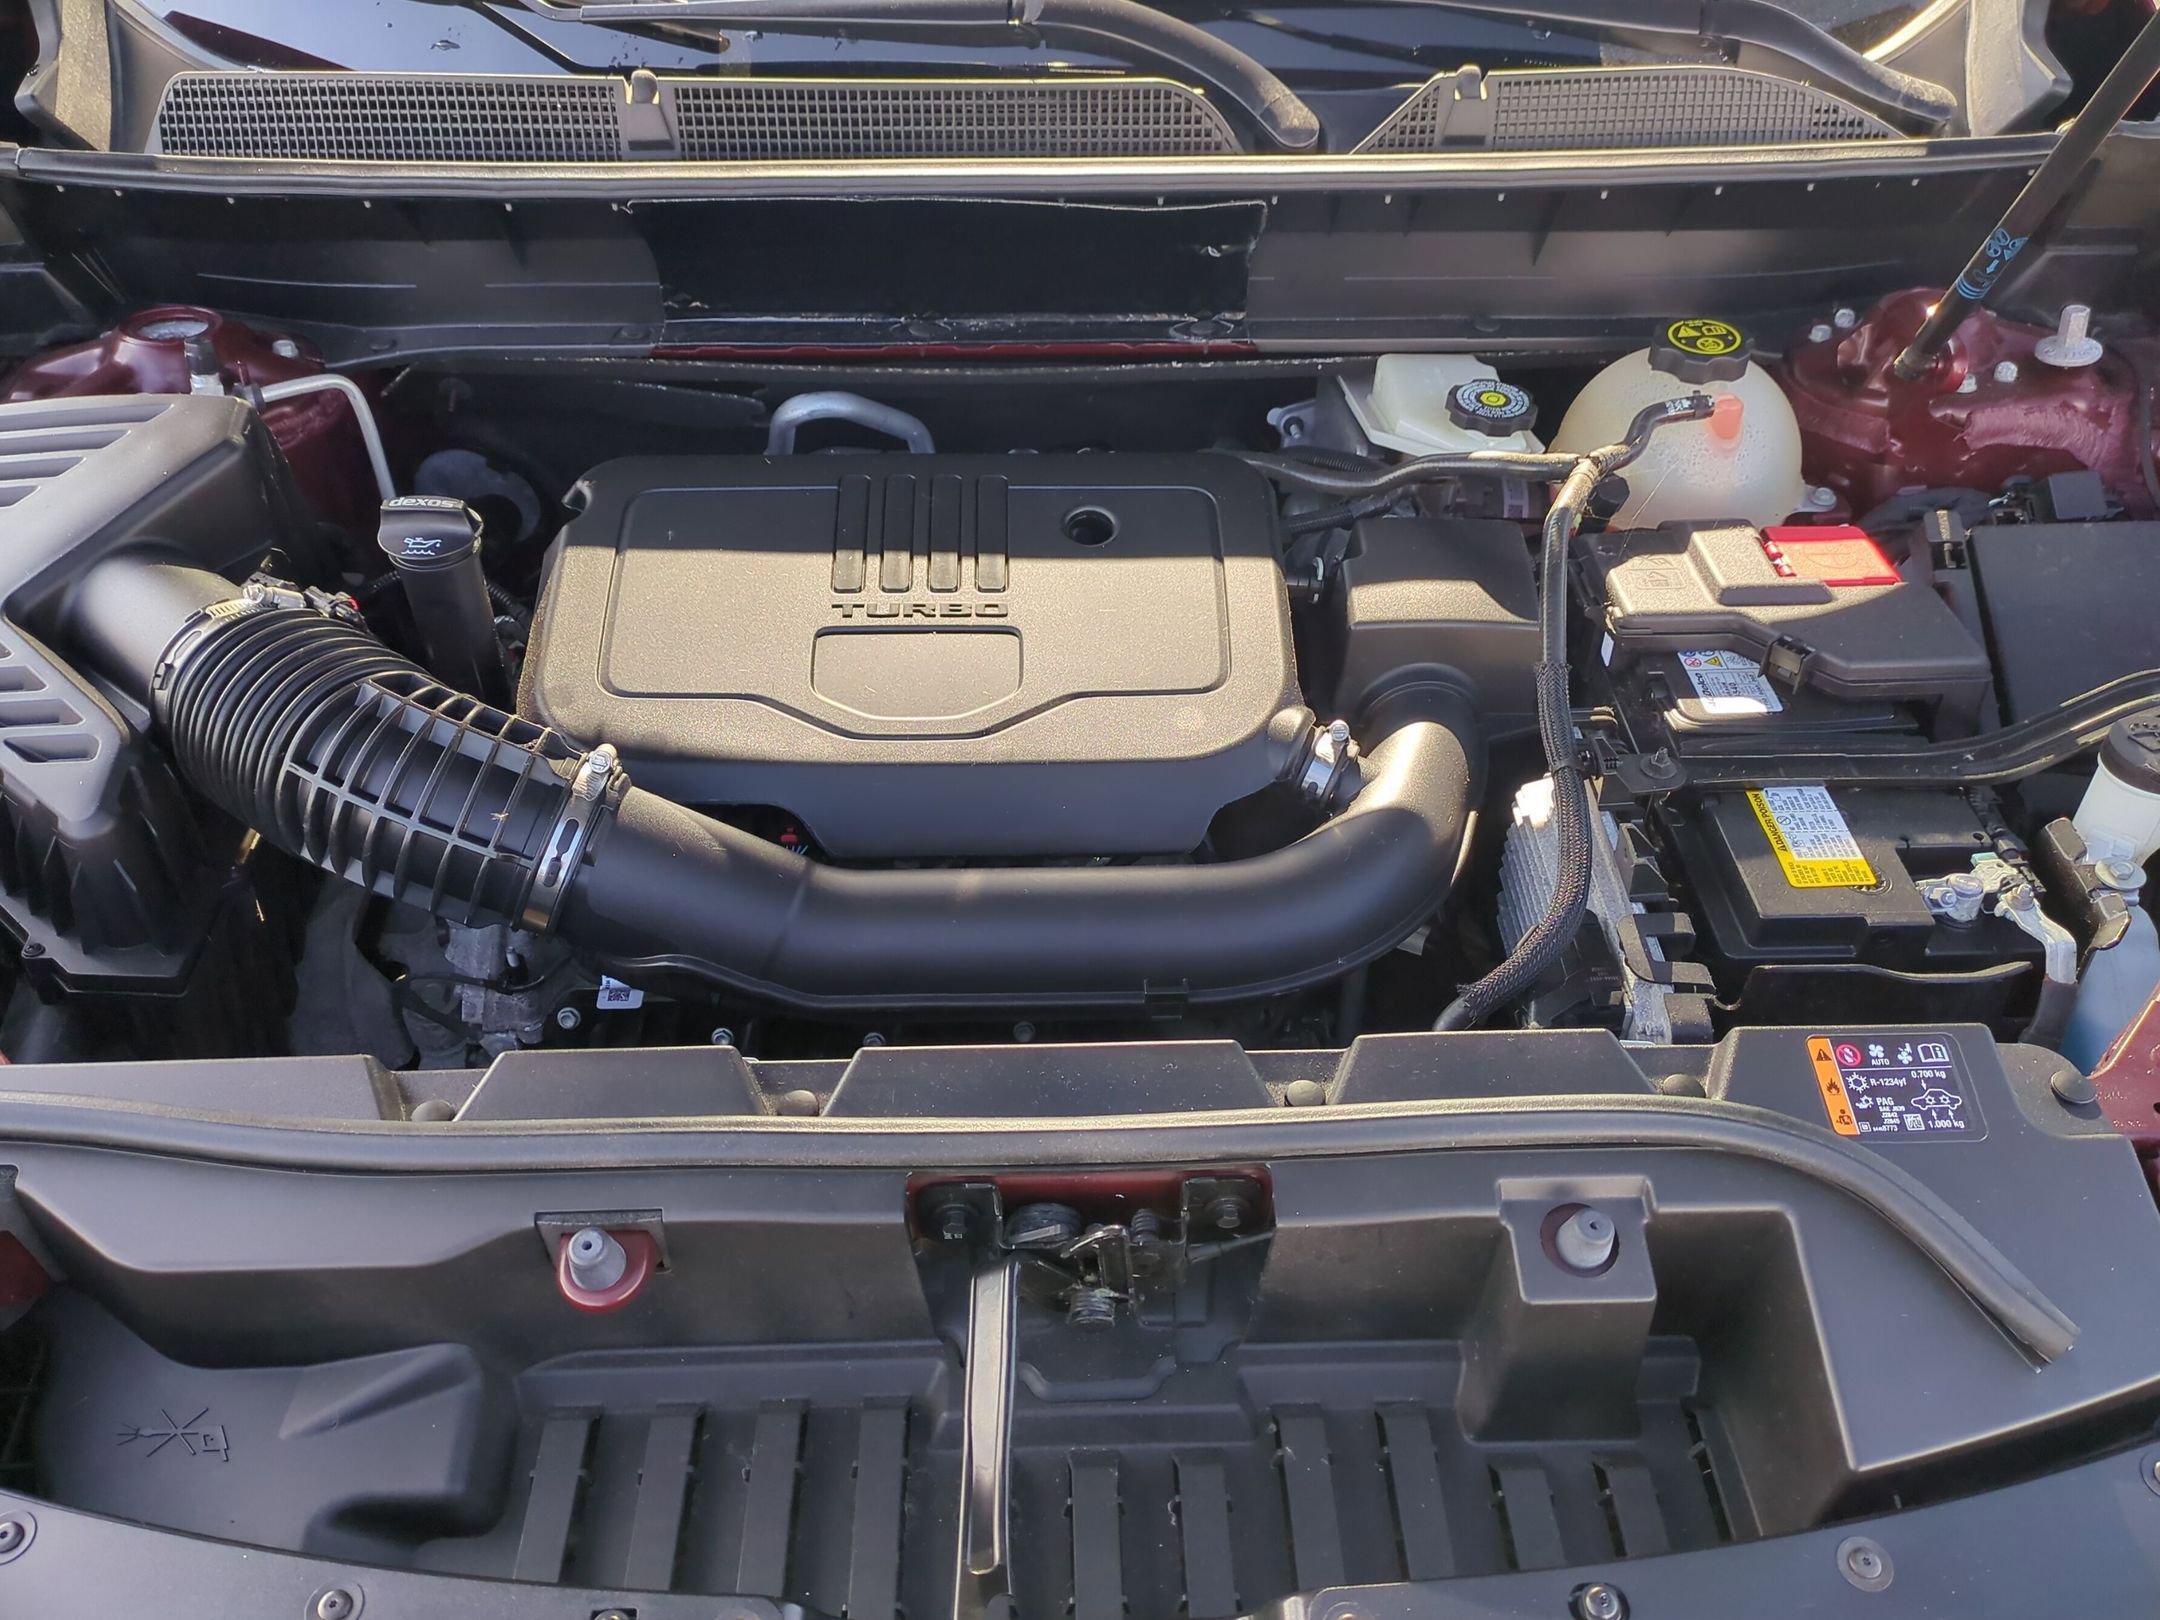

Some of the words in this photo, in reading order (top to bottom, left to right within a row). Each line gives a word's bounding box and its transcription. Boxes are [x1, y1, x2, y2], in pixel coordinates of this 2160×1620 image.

[389, 497, 458, 508] dexos
[831, 603, 1008, 618] TURBO
[1752, 793, 1770, 819] POISON
[1765, 819, 1786, 845] DANGER
[1911, 1070, 1933, 1078] 0.700
[1934, 1069, 1946, 1079] kg
[1876, 1097, 1894, 1106] PAG
[1928, 1119, 1952, 1129] 1.000
[1952, 1119, 1965, 1129] kg
